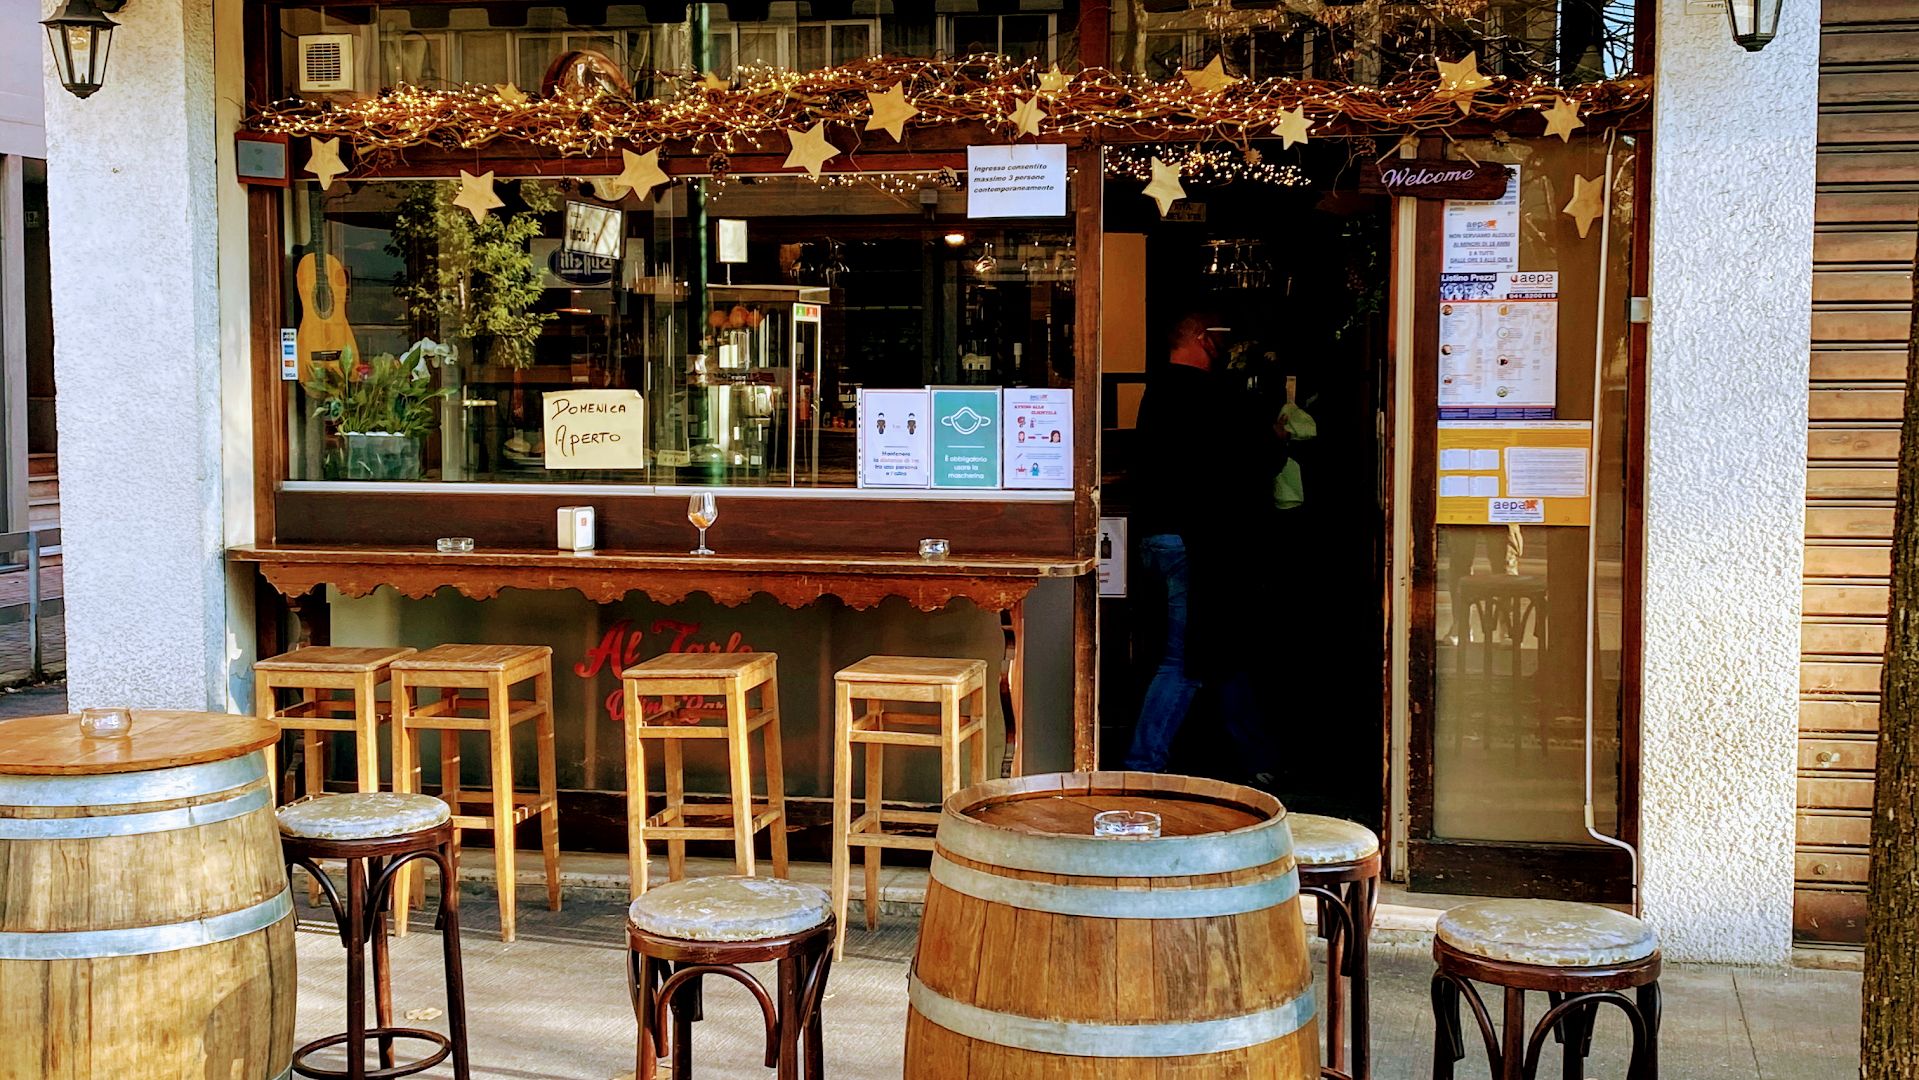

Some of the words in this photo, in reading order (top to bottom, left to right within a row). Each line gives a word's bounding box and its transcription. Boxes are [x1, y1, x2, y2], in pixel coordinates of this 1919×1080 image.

[973, 165, 1006, 173] Ingresso
[1014, 174, 1046, 182] persone
[1380, 167, 1476, 189] Welcome
[973, 185, 1055, 193] contemporaneamente
[1441, 273, 1469, 282] Listino
[1470, 273, 1496, 281] Prezzi
[551, 398, 626, 420] DOMENICA
[555, 424, 621, 458] APERTO
[949, 455, 988, 464] obbligatorio
[947, 472, 985, 480] mascherina
[573, 618, 643, 681] Al
